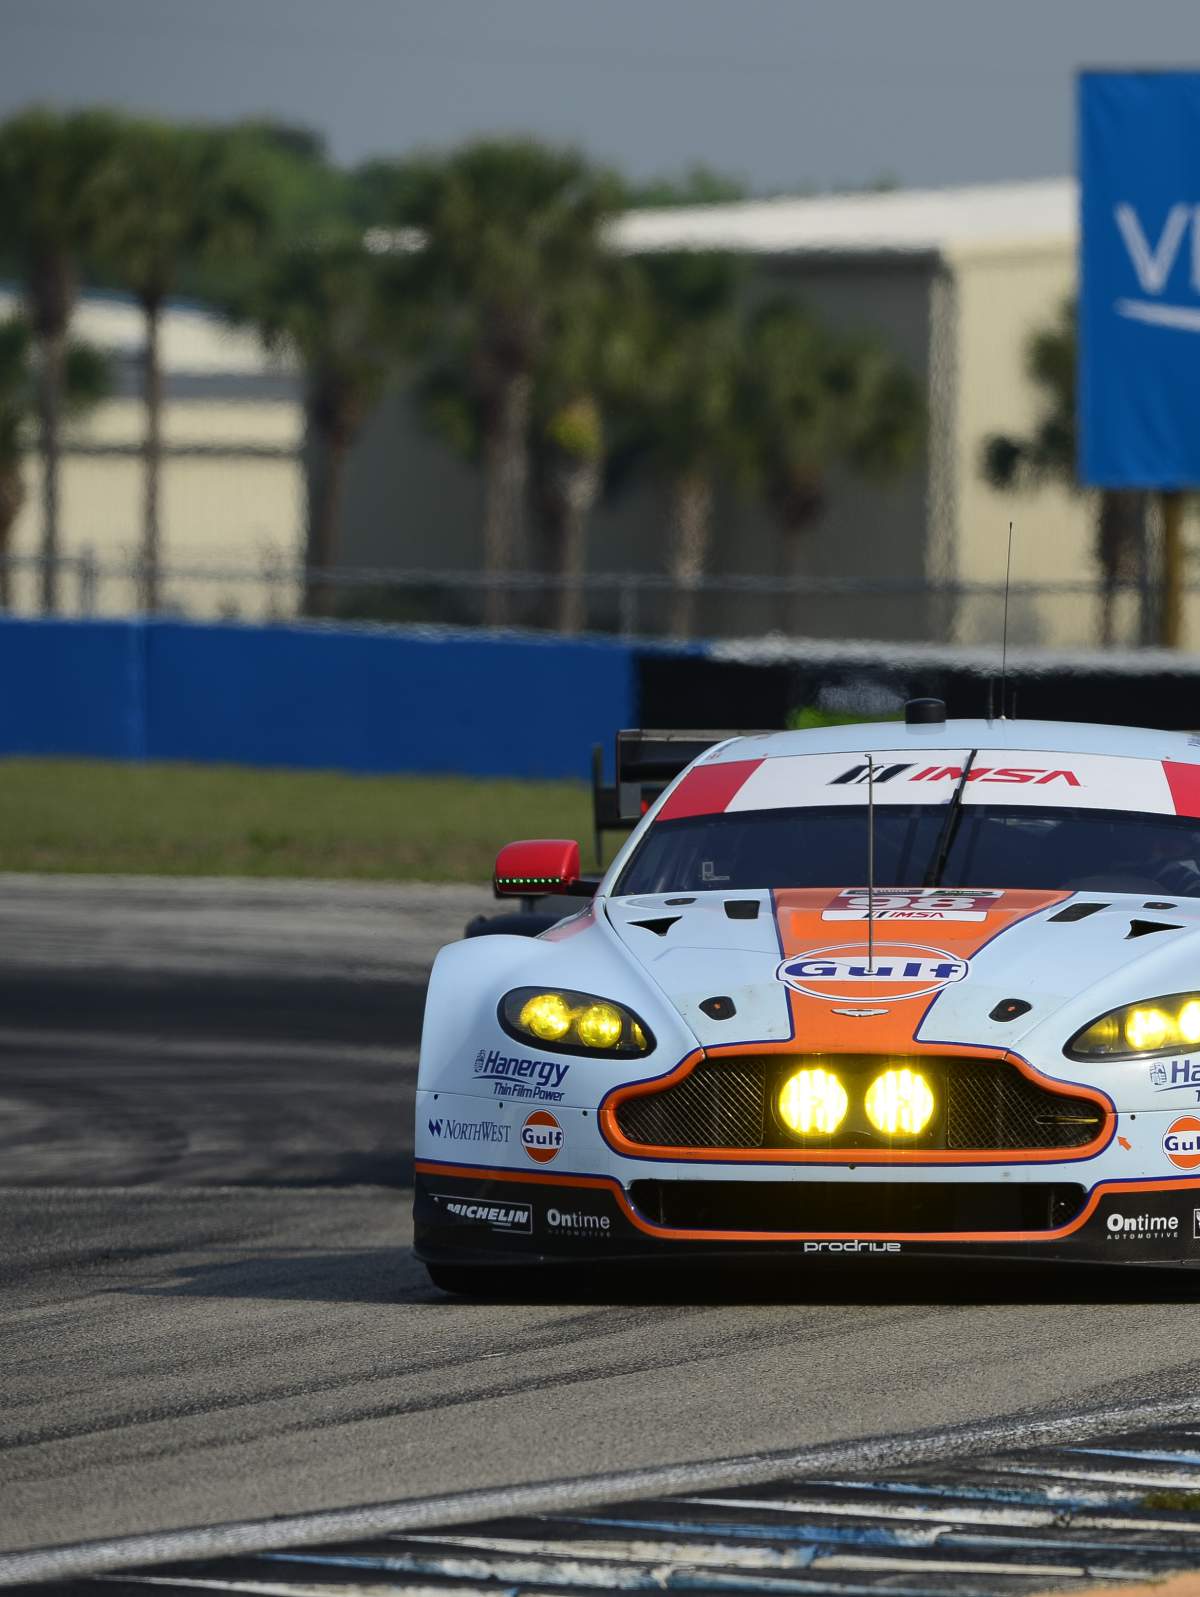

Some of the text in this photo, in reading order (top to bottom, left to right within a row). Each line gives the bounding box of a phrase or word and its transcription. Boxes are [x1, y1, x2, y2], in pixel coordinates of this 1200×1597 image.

[908, 766, 1081, 786] IMSA
[847, 897, 976, 910] 98
[889, 911, 944, 919] IMSA
[785, 960, 961, 979] Gulf
[483, 1050, 570, 1088] Hanergy
[494, 1082, 565, 1102] Thin Film Power
[522, 1127, 562, 1146] Gulf
[446, 1203, 529, 1224] MICHELIN
[547, 1208, 611, 1229] Ontime
[1106, 1213, 1179, 1232] Ontime
[803, 1239, 902, 1252] prodrive
[1106, 1232, 1179, 1240] AUTOMOTIVE
